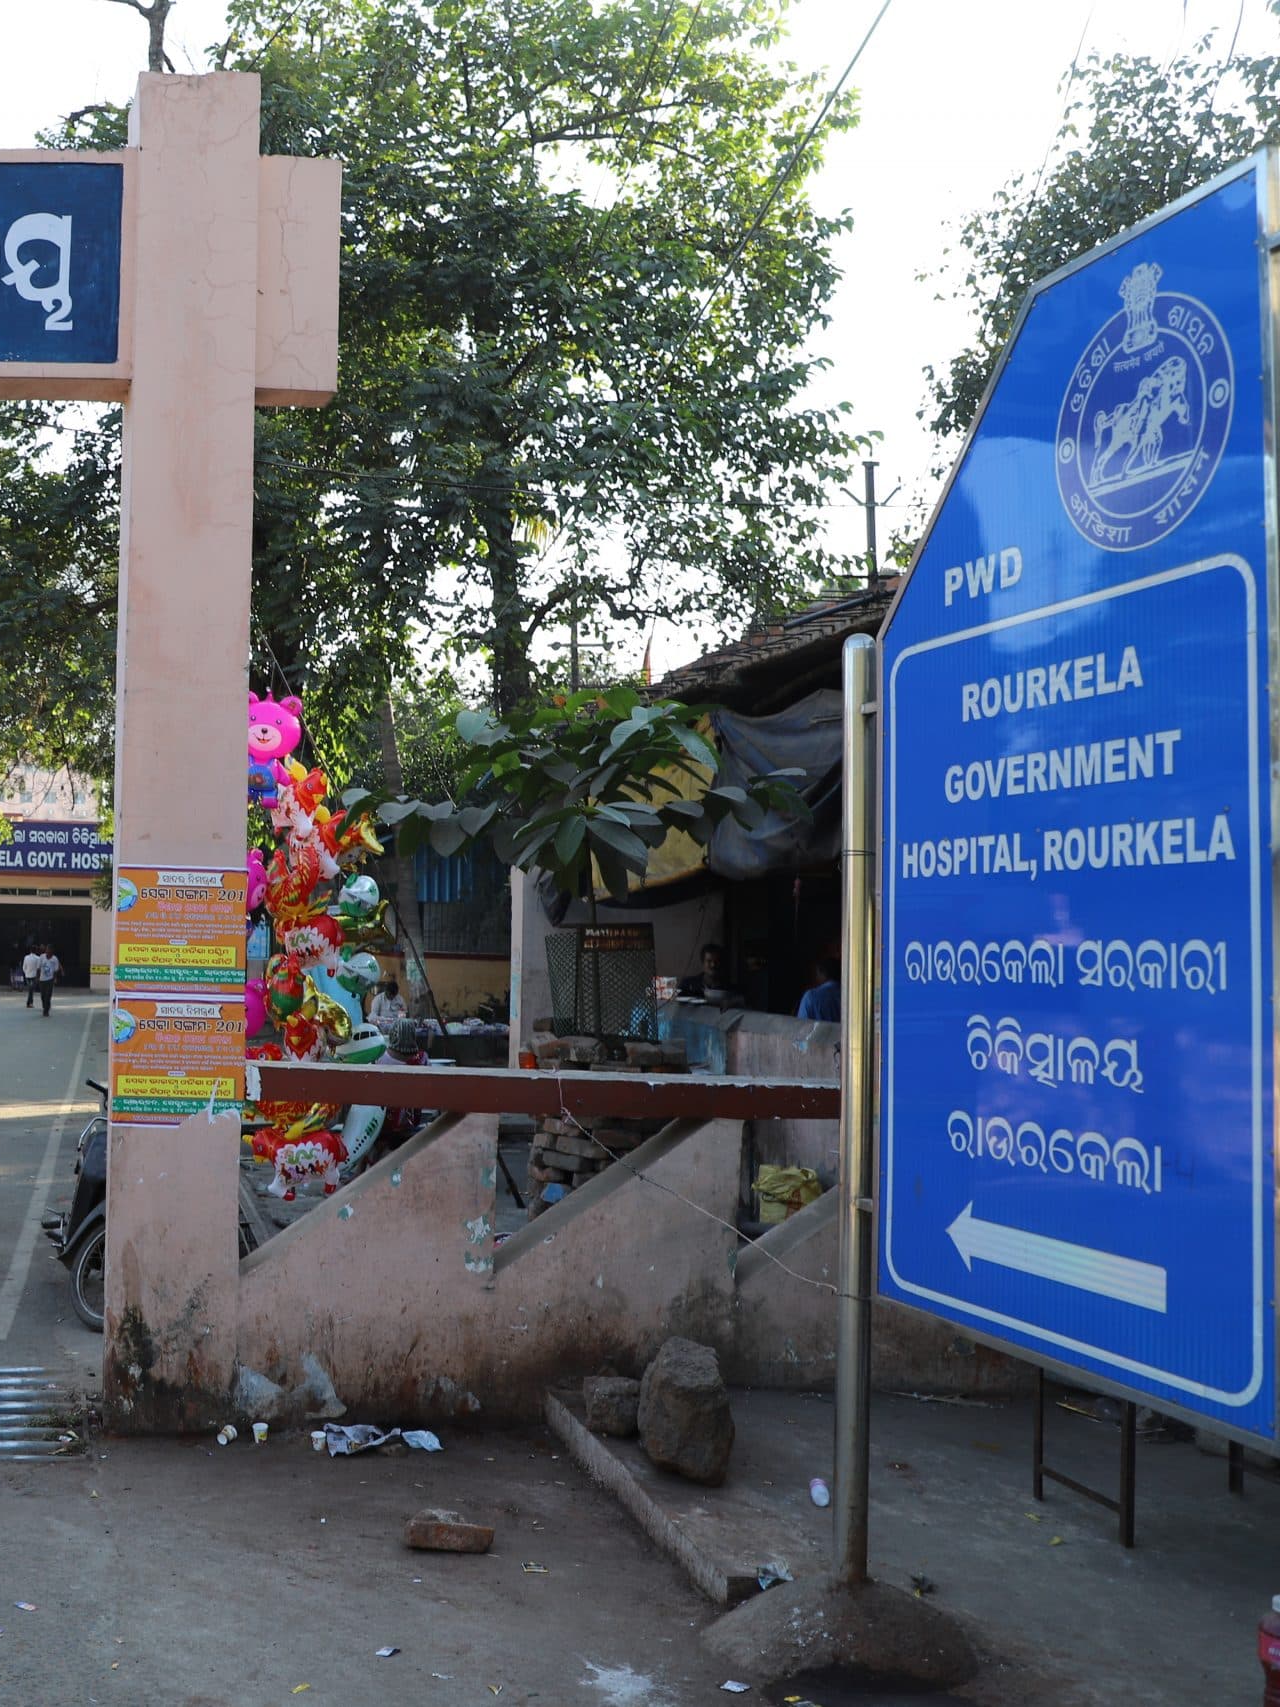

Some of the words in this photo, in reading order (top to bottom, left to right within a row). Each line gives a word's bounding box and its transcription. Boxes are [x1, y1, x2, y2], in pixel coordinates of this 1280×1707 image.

[944, 546, 1022, 607] PWD
[962, 645, 1143, 722] ROURKELA
[944, 729, 1182, 803] GOVERNMENT
[27, 851, 68, 869] GOVT.
[902, 832, 1037, 881] HOSPITAL,
[1043, 814, 1236, 873] ROURKELA
[905, 940, 1064, 988] ରାଉରକେଲା
[1076, 939, 1227, 994] ସରକାରୀ
[967, 1014, 1144, 1093] ଚିକିତ୍ସାଳୟ
[947, 1110, 1162, 1194] ରାଉରକେଲା
